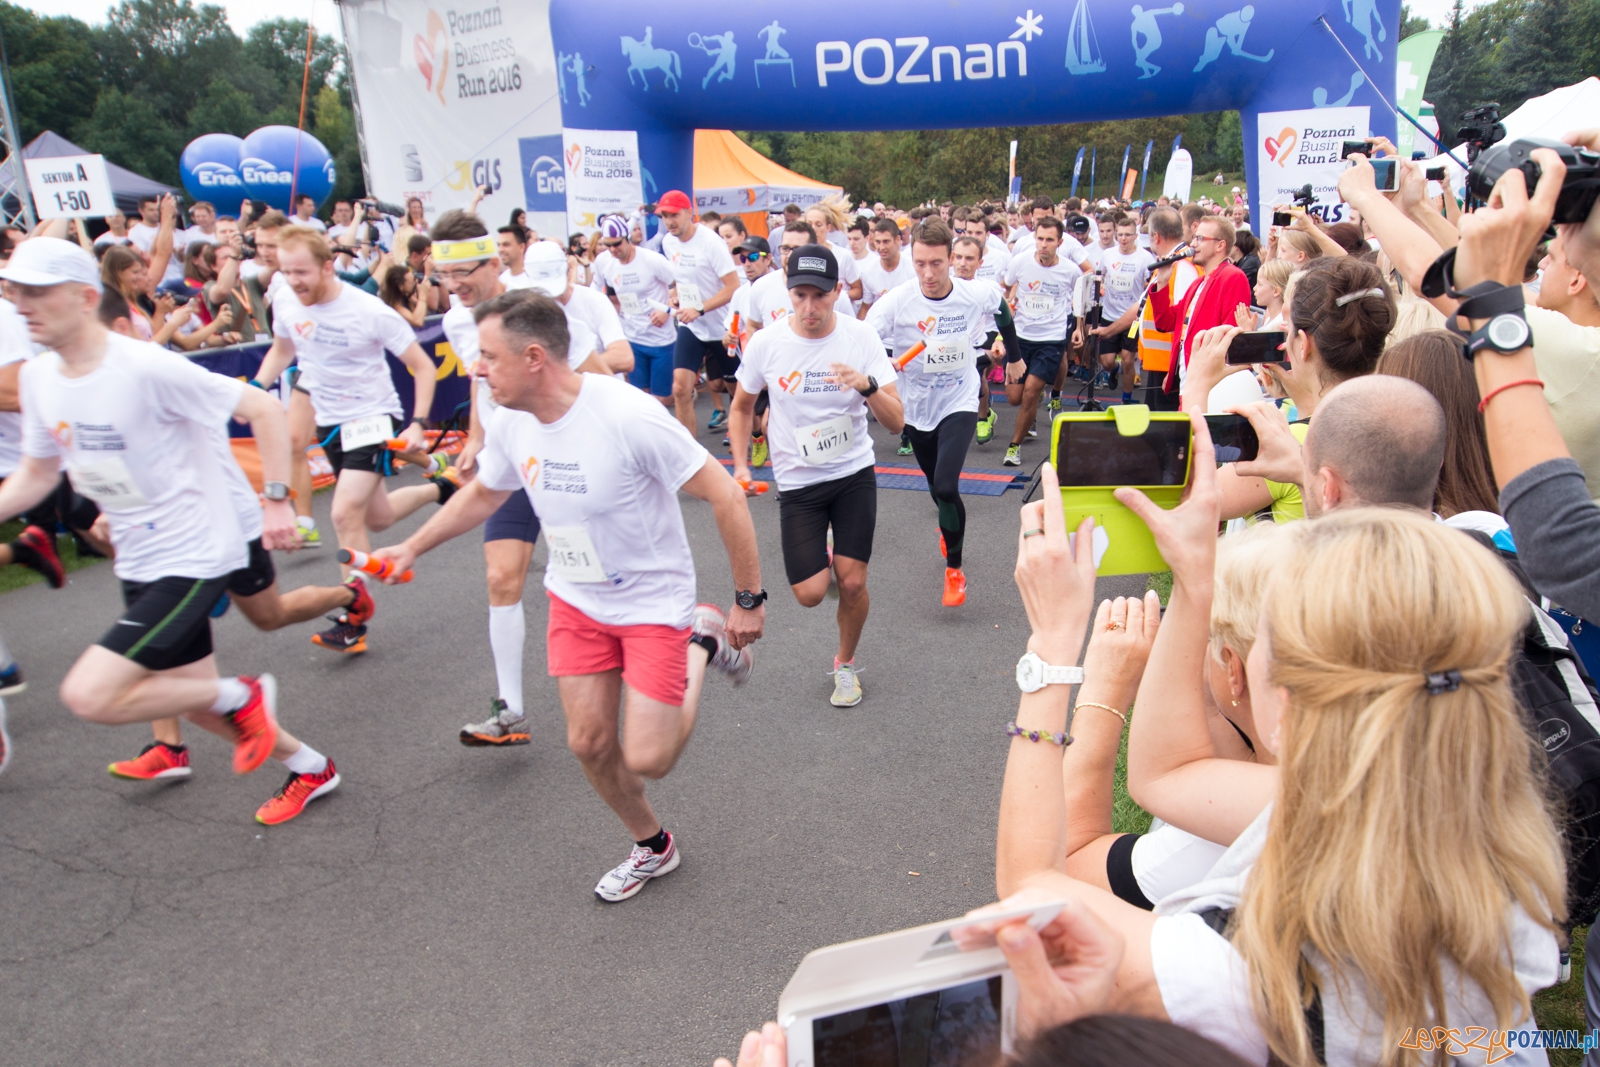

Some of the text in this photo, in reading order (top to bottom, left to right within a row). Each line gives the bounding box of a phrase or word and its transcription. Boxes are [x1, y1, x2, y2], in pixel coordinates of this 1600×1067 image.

[454, 37, 516, 68] Business
[457, 63, 522, 98] Run 2016
[1302, 125, 1355, 139] Poznań
[585, 146, 625, 157] Poznań
[1300, 140, 1338, 153] Busin
[584, 157, 631, 168] Business
[1297, 154, 1325, 165] Run
[42, 163, 88, 184] SEKTOR A
[198, 170, 242, 186] Ene
[243, 166, 293, 184] Enea
[473, 159, 501, 190] GLS
[584, 168, 633, 178] Run 2016
[536, 171, 565, 194] Ene
[53, 190, 91, 212] 1-50
[816, 431, 848, 451] 407/1
